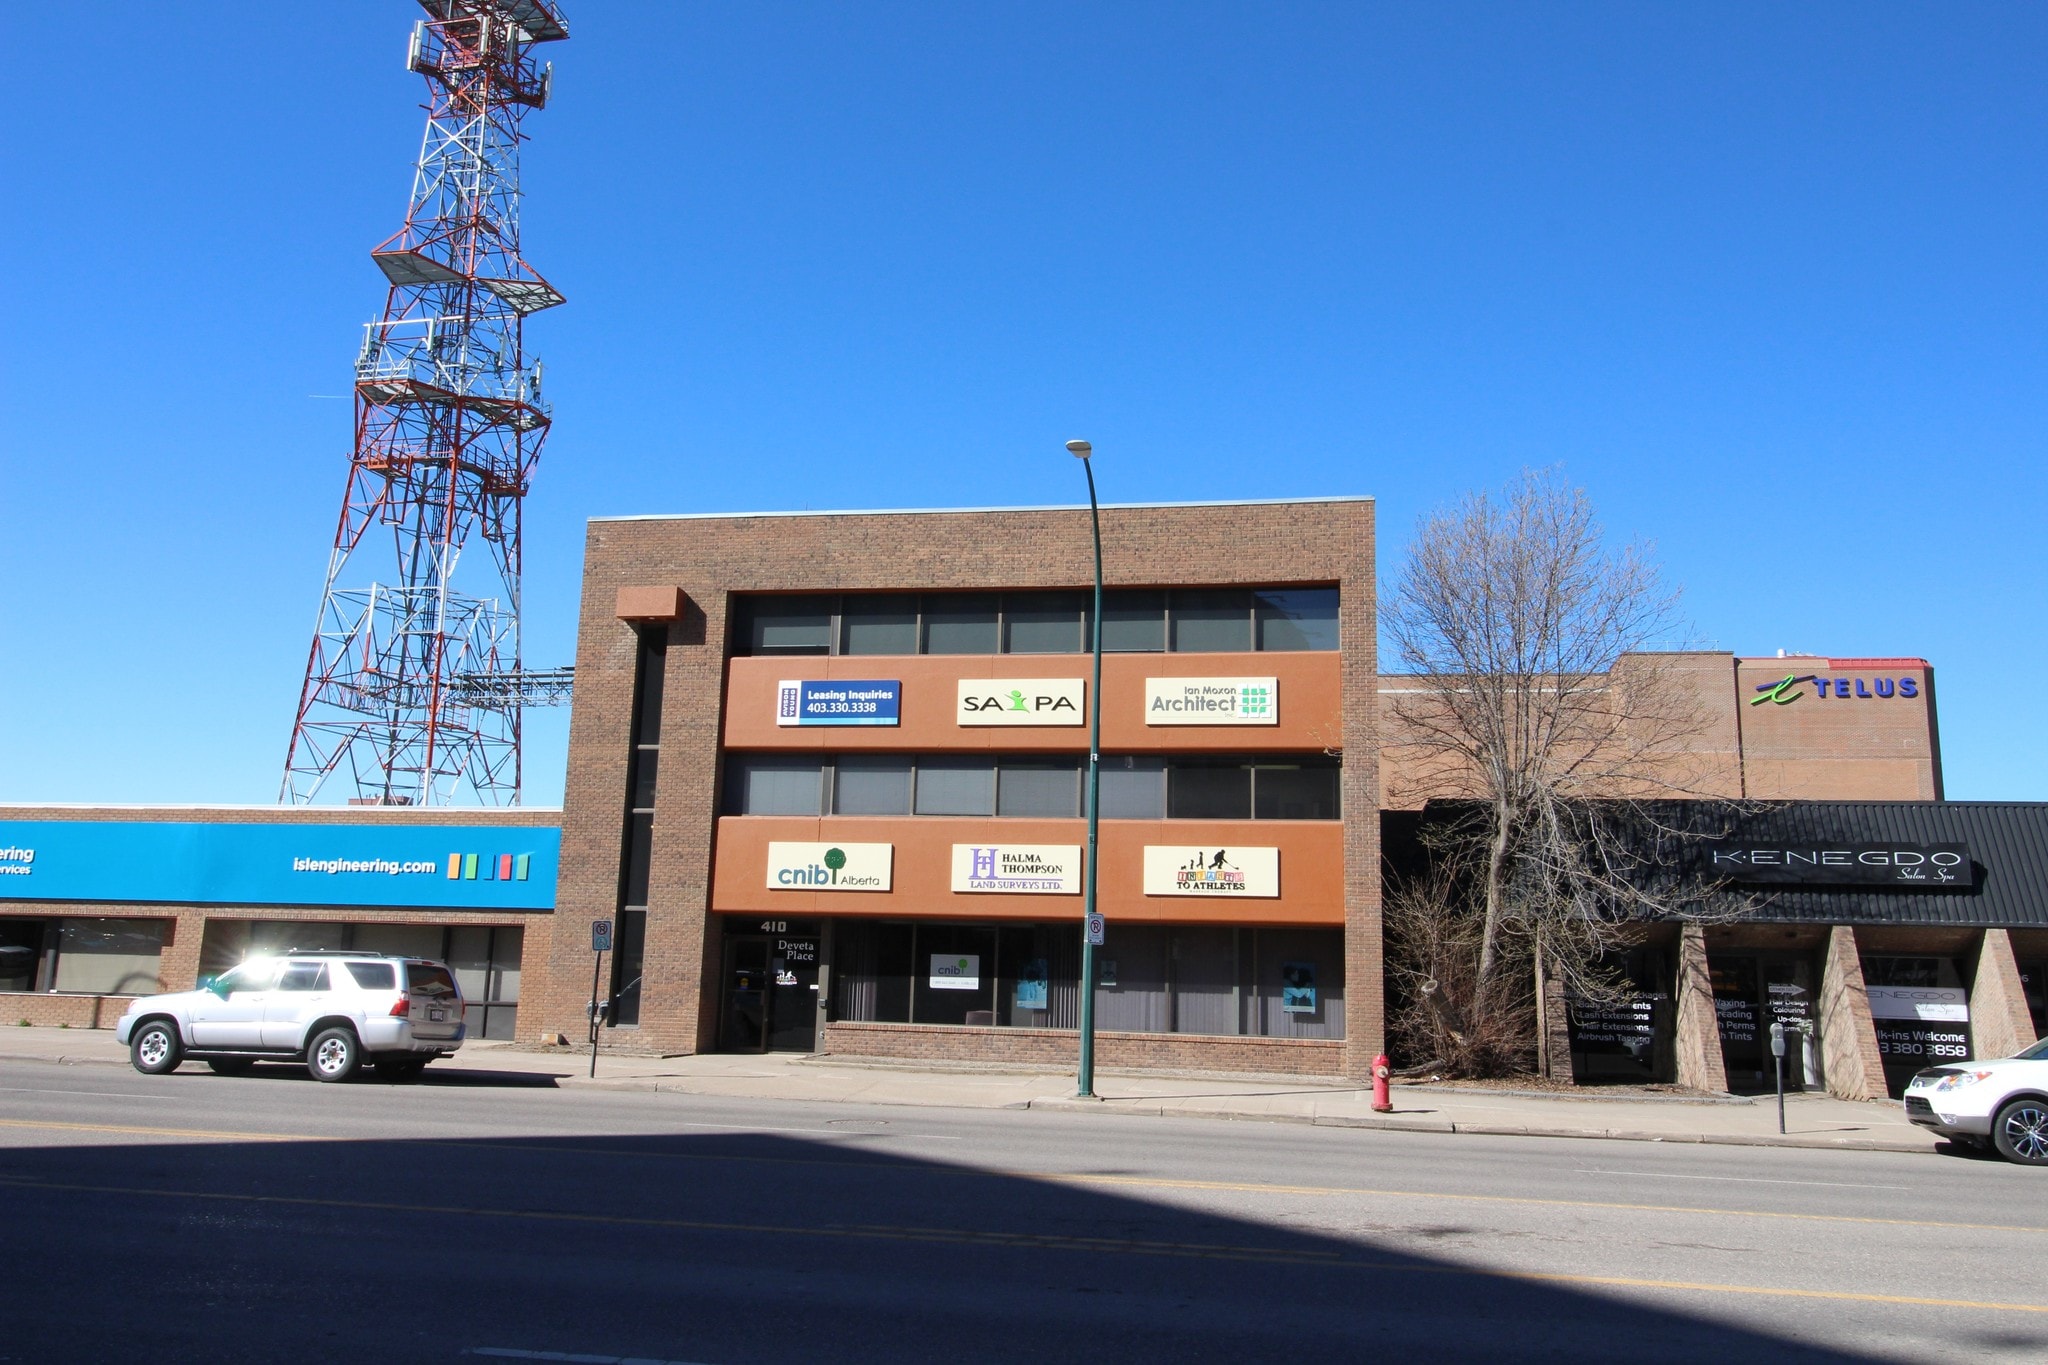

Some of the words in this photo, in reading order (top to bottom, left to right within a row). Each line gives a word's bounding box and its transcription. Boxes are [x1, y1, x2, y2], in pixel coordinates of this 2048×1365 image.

[1184, 686, 1200, 695] Ian
[1202, 686, 1237, 695] Moxon
[1812, 677, 1918, 698] TELUS
[808, 690, 846, 702] Leasing
[848, 690, 893, 702] Inquiries
[807, 702, 877, 713] 403.330.3338
[1152, 696, 1237, 712] Architect
[1002, 854, 1042, 863] HALMA
[0, 864, 32, 875] rvices
[294, 857, 436, 874] islengineering.com
[1002, 864, 1063, 874] THOMPSON
[778, 864, 830, 885] cnib
[840, 876, 880, 886] Alberta
[1897, 867, 1926, 880] Salon
[1934, 867, 1955, 882] Spa
[970, 881, 996, 889] LAND
[998, 882, 1040, 890] SURVEYS
[1041, 882, 1063, 890] LTD.
[1177, 882, 1190, 890] TO
[1193, 882, 1246, 890] ATHLETES
[761, 921, 787, 932] 410
[778, 940, 814, 950] Deveta
[786, 950, 814, 960] Place
[938, 965, 960, 976] cnib
[1772, 1006, 1806, 1014] Colouring
[1580, 1011, 1600, 1020] Lash
[1602, 1012, 1650, 1020] Extensions
[1602, 1022, 1650, 1032] Extensions
[1726, 1022, 1756, 1030] Perms
[1577, 1032, 1614, 1041] Airbrush
[1728, 1032, 1752, 1040] Tints
[1912, 1030, 1966, 1043] Welcome
[1892, 1043, 1923, 1054] 380
[1926, 1044, 1967, 1057] 3858
